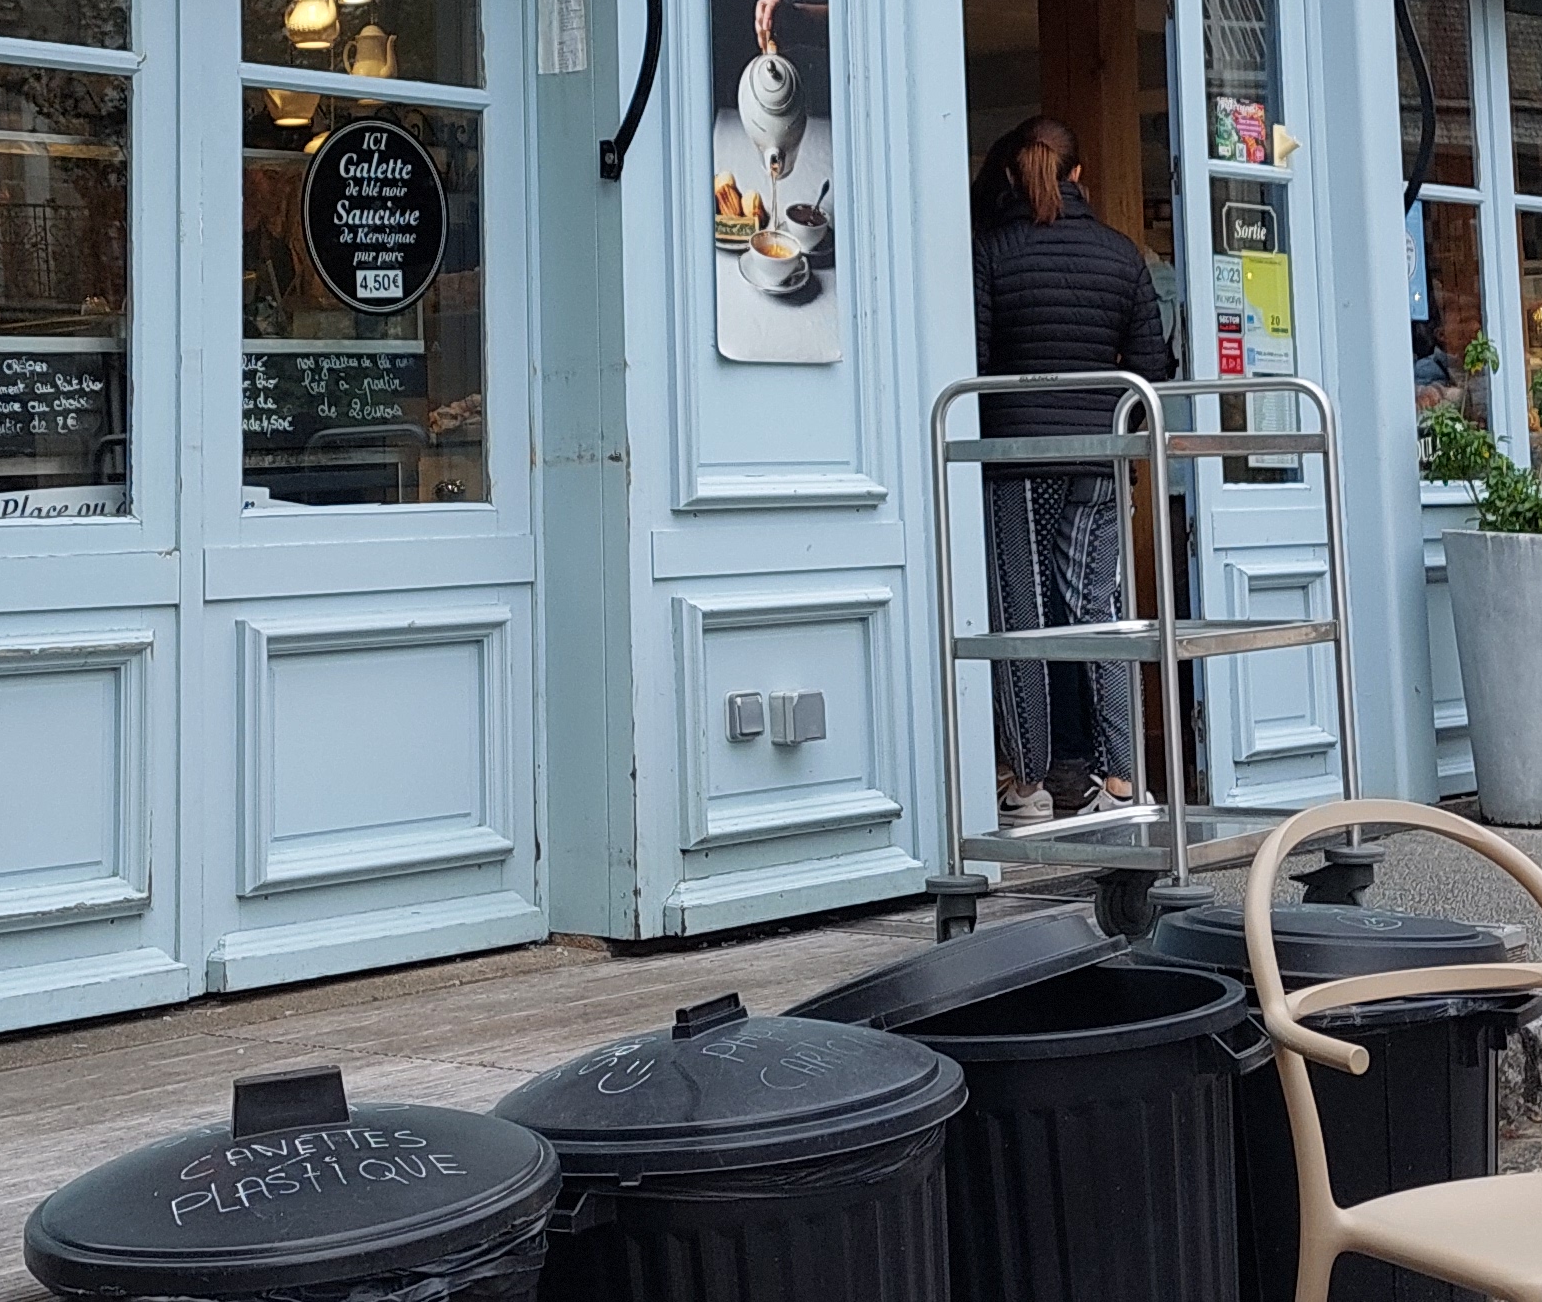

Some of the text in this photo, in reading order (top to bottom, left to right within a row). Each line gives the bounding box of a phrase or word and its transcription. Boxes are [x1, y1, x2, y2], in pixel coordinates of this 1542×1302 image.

[362, 133, 388, 150] ICI
[339, 151, 412, 179] Galette
[346, 179, 408, 197] de blé noir
[334, 200, 420, 225] Saucisse
[340, 227, 417, 248] de Kervignac
[1234, 219, 1267, 241] Sortie
[353, 251, 404, 266] pur porc
[359, 273, 400, 294] 4,50€
[1216, 265, 1241, 283] 2023
[34, 382, 55, 393] au
[28, 401, 50, 412] au
[318, 397, 337, 418] de
[30, 415, 49, 433] de
[1, 494, 69, 518] Place
[180, 1127, 428, 1181] CANETTES
